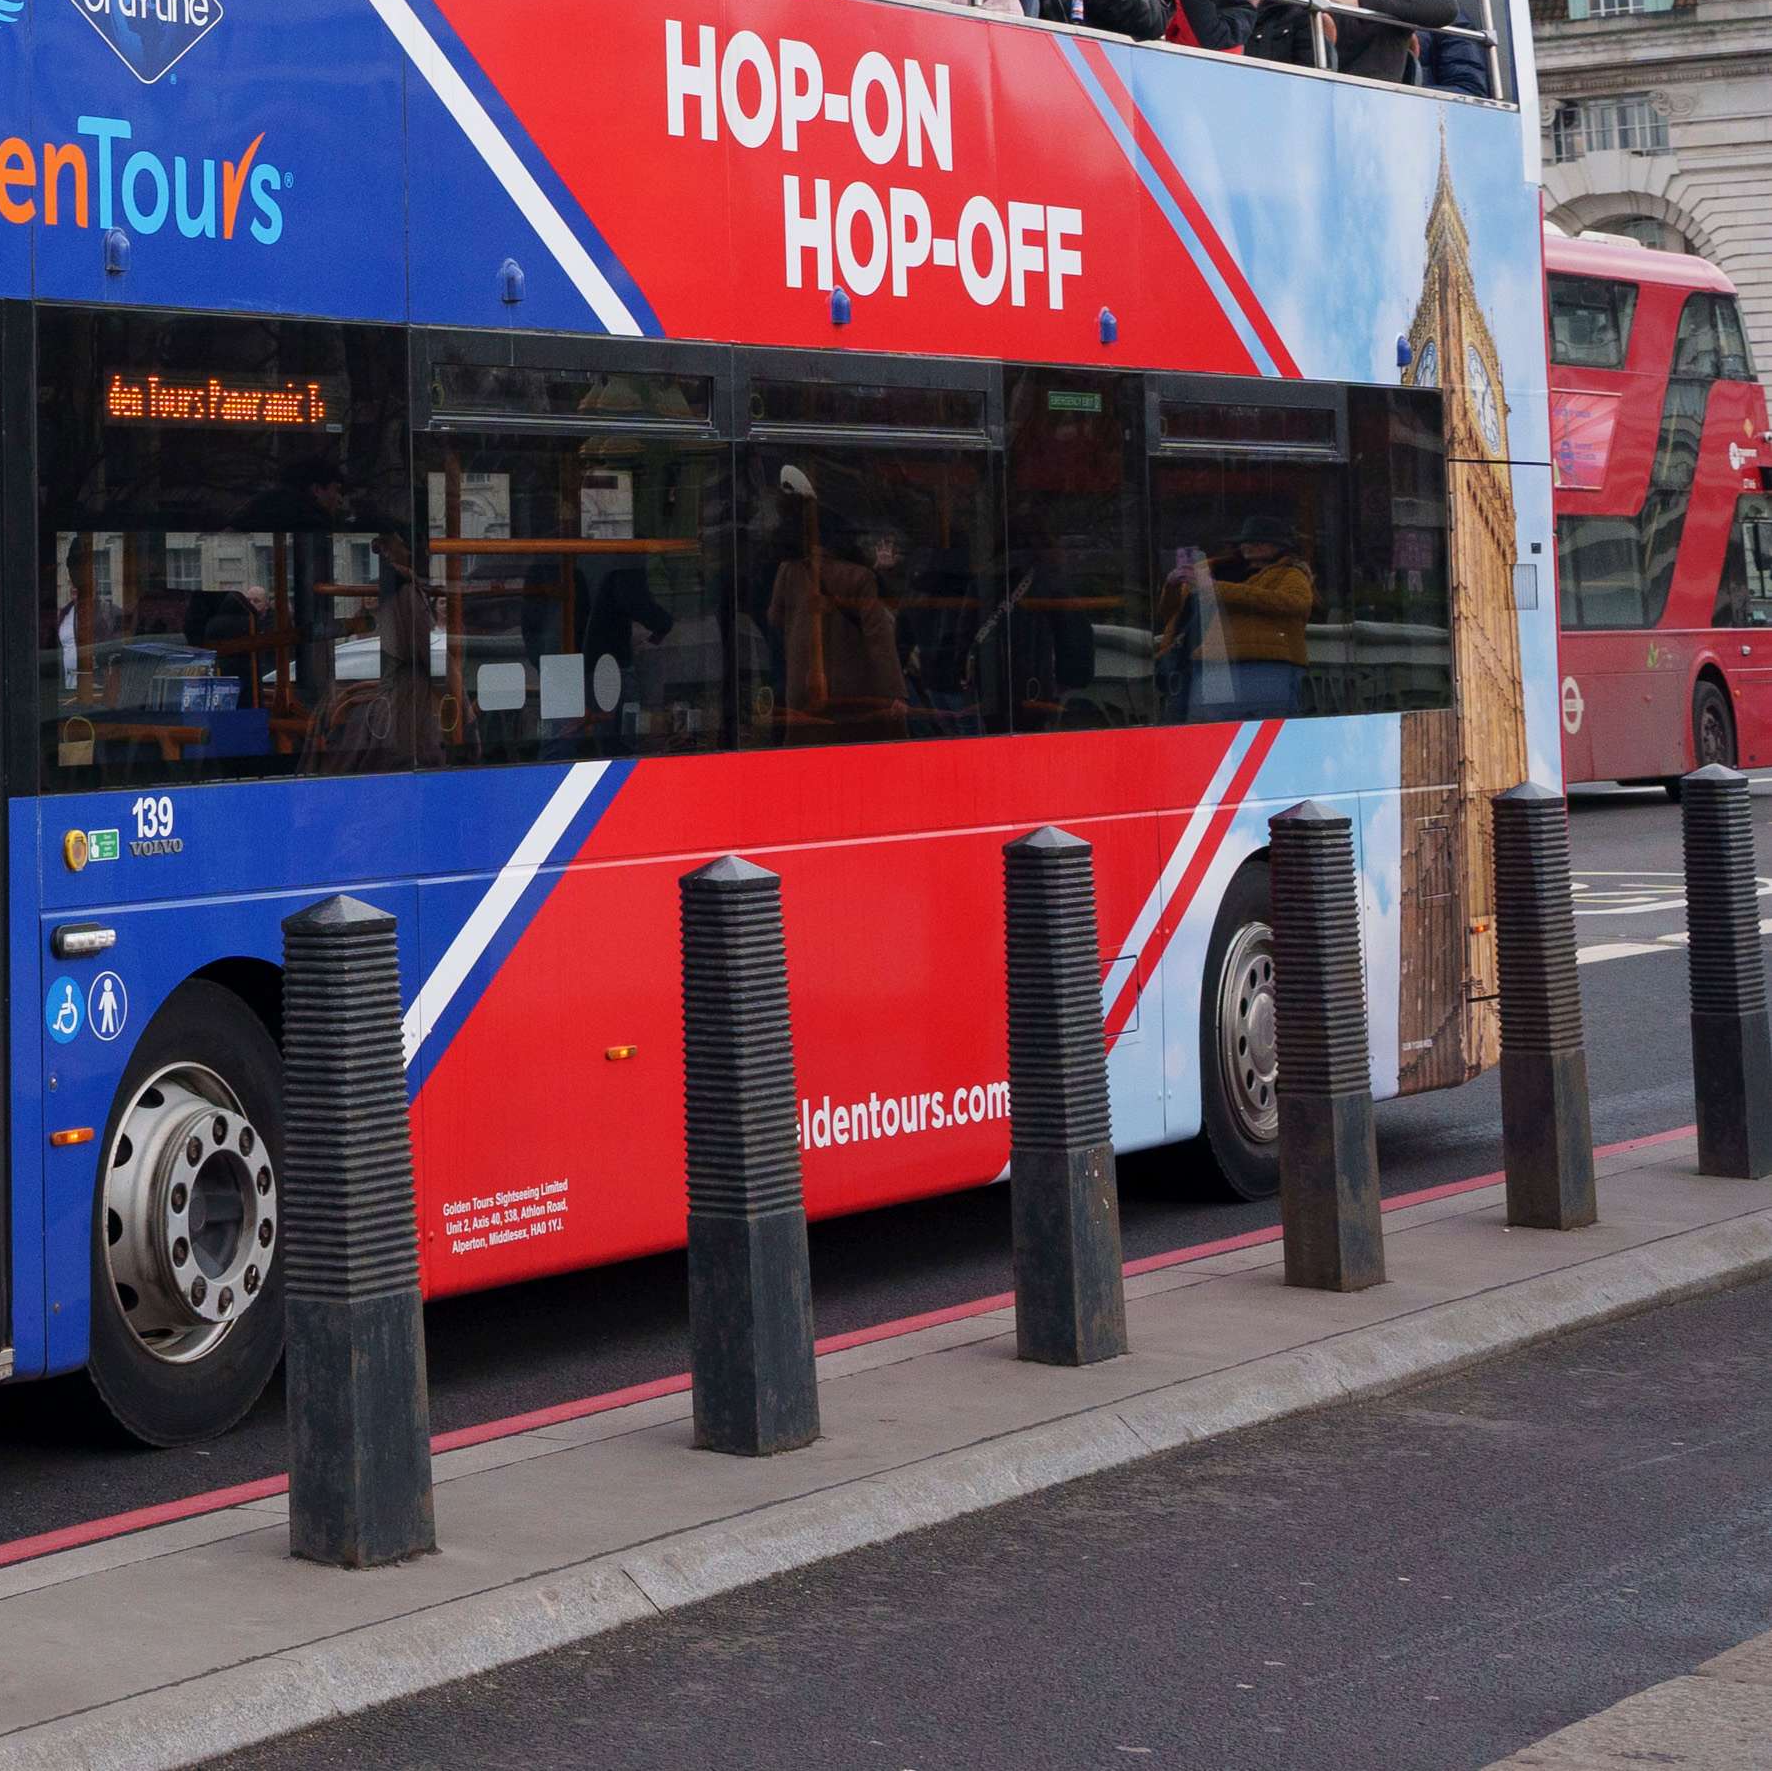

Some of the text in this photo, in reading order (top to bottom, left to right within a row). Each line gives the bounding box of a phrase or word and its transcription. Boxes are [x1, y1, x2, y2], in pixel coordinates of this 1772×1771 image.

[665, 19, 954, 172] HOP-ON
[783, 174, 1083, 311] HOP-OFF
[147, 375, 205, 419] Tours
[209, 378, 304, 423] Panoramic
[132, 796, 174, 839] 139
[129, 838, 184, 857] VOLVO
[443, 1178, 569, 1216] Golden Tours Sightseeing Limited
[446, 1221, 462, 1235] Unit
[464, 1219, 471, 1233] 2,
[472, 1215, 489, 1230] Axis
[520, 1204, 545, 1219] Athlon
[546, 1197, 569, 1213] Road,
[452, 1237, 488, 1255] Alperton,
[488, 1228, 530, 1246] Middlesex,
